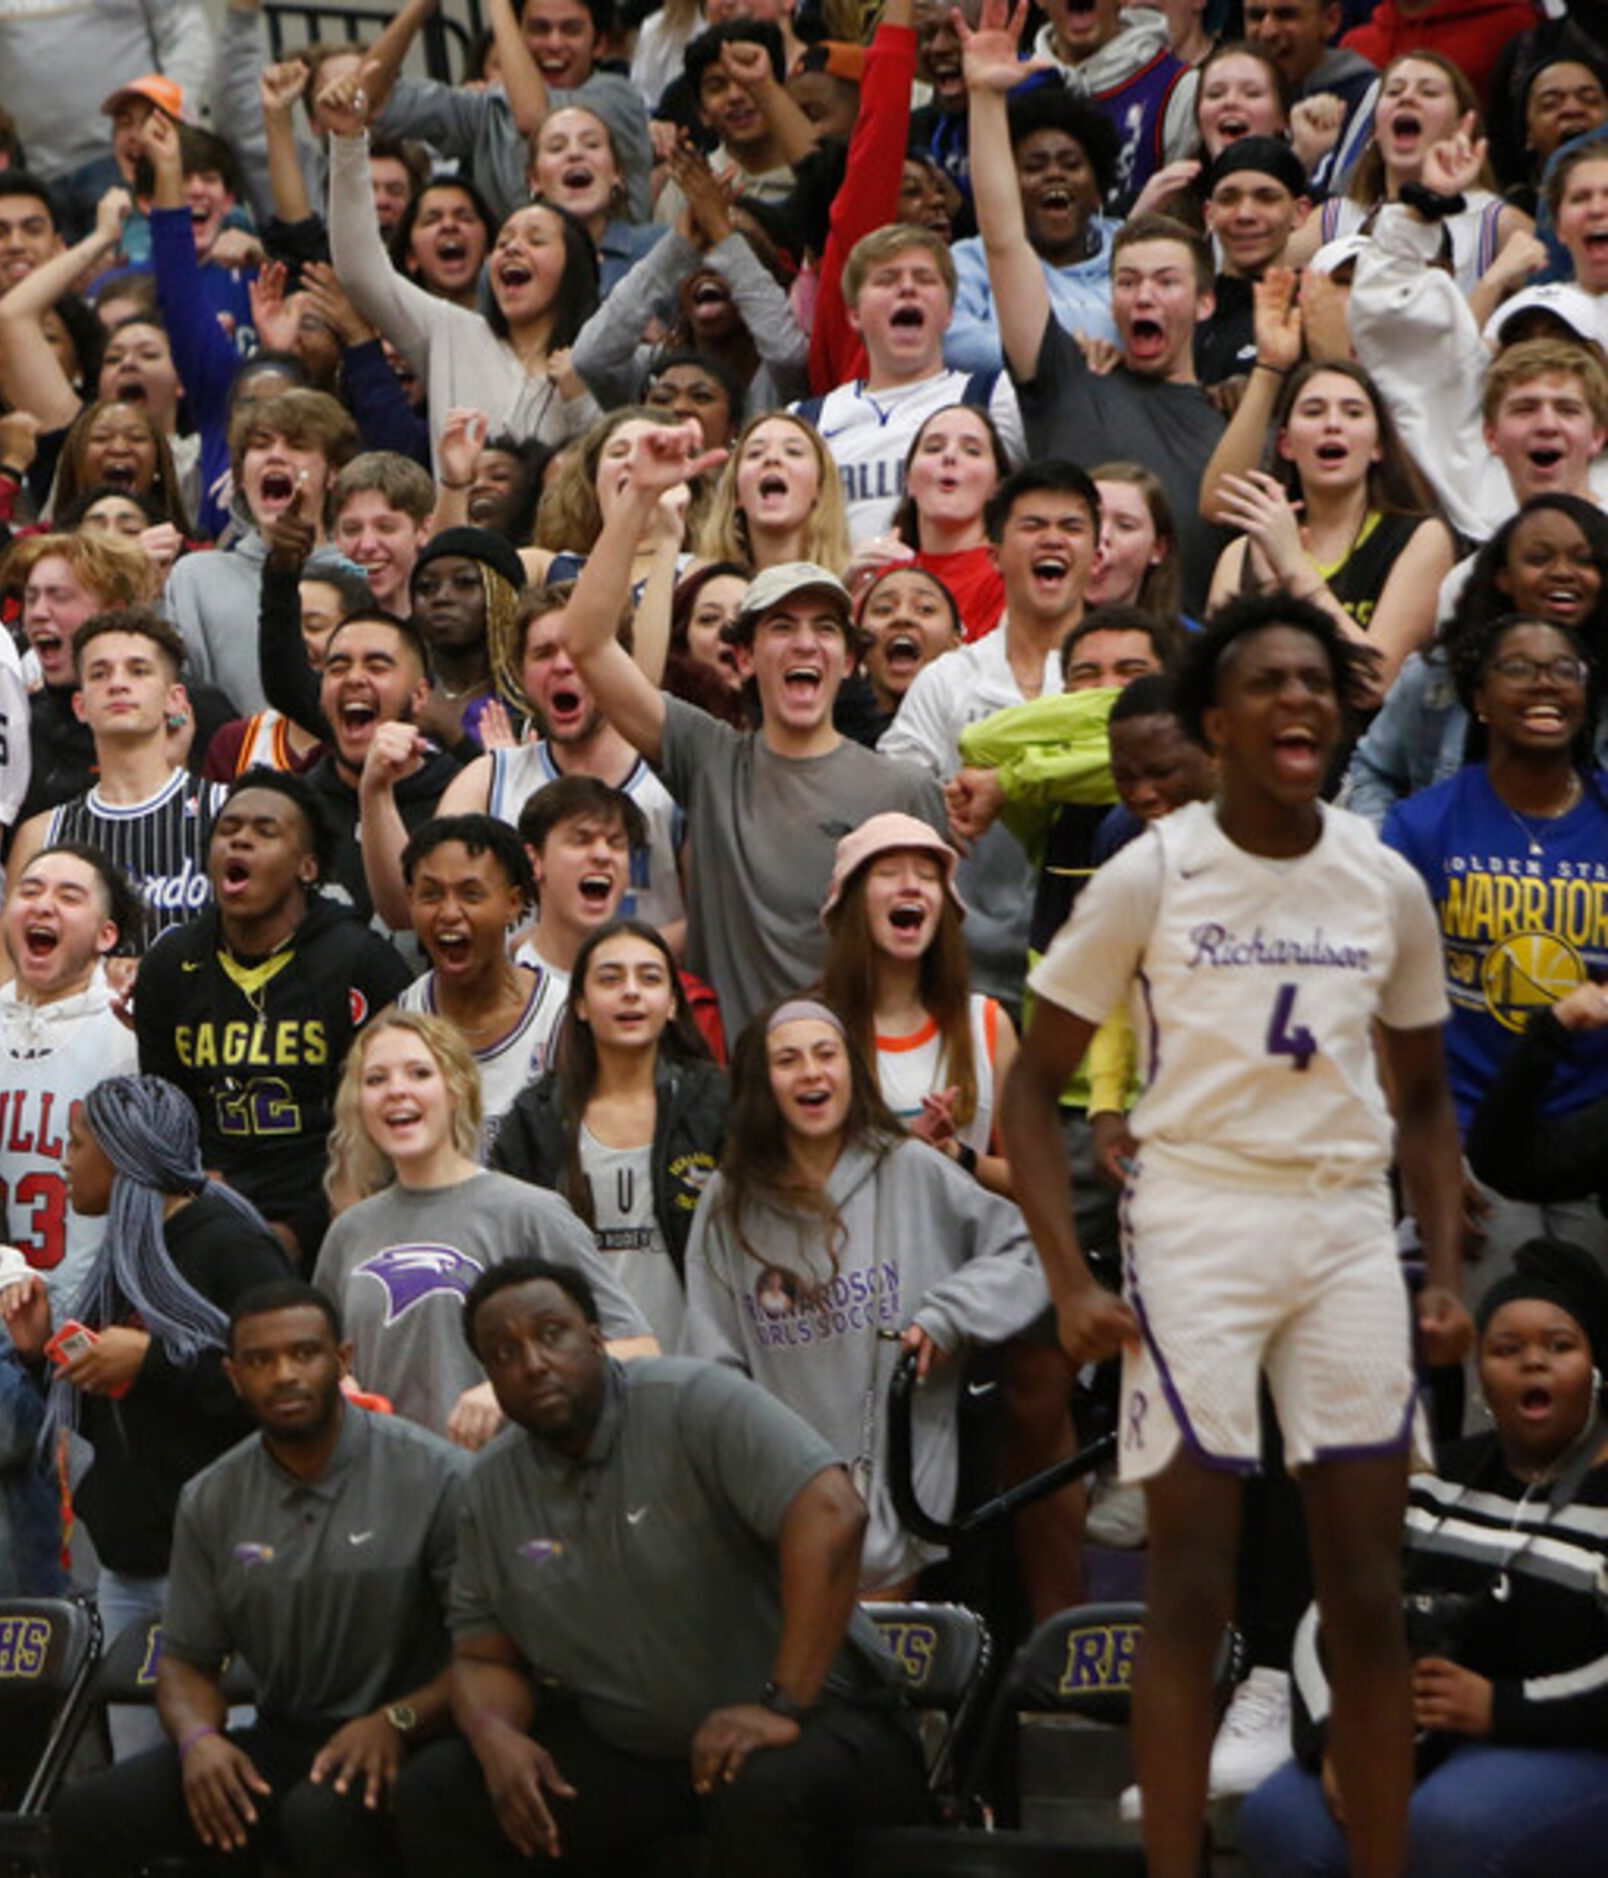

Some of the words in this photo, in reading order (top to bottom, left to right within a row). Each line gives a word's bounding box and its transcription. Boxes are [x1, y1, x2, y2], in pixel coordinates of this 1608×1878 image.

[143, 857, 209, 909] ndo
[1188, 922, 1370, 971] Richardson
[174, 1018, 329, 1068] EAGLES
[1265, 981, 1318, 1072] 4
[617, 1167, 633, 1216] U
[1059, 1624, 1145, 1695] RH
